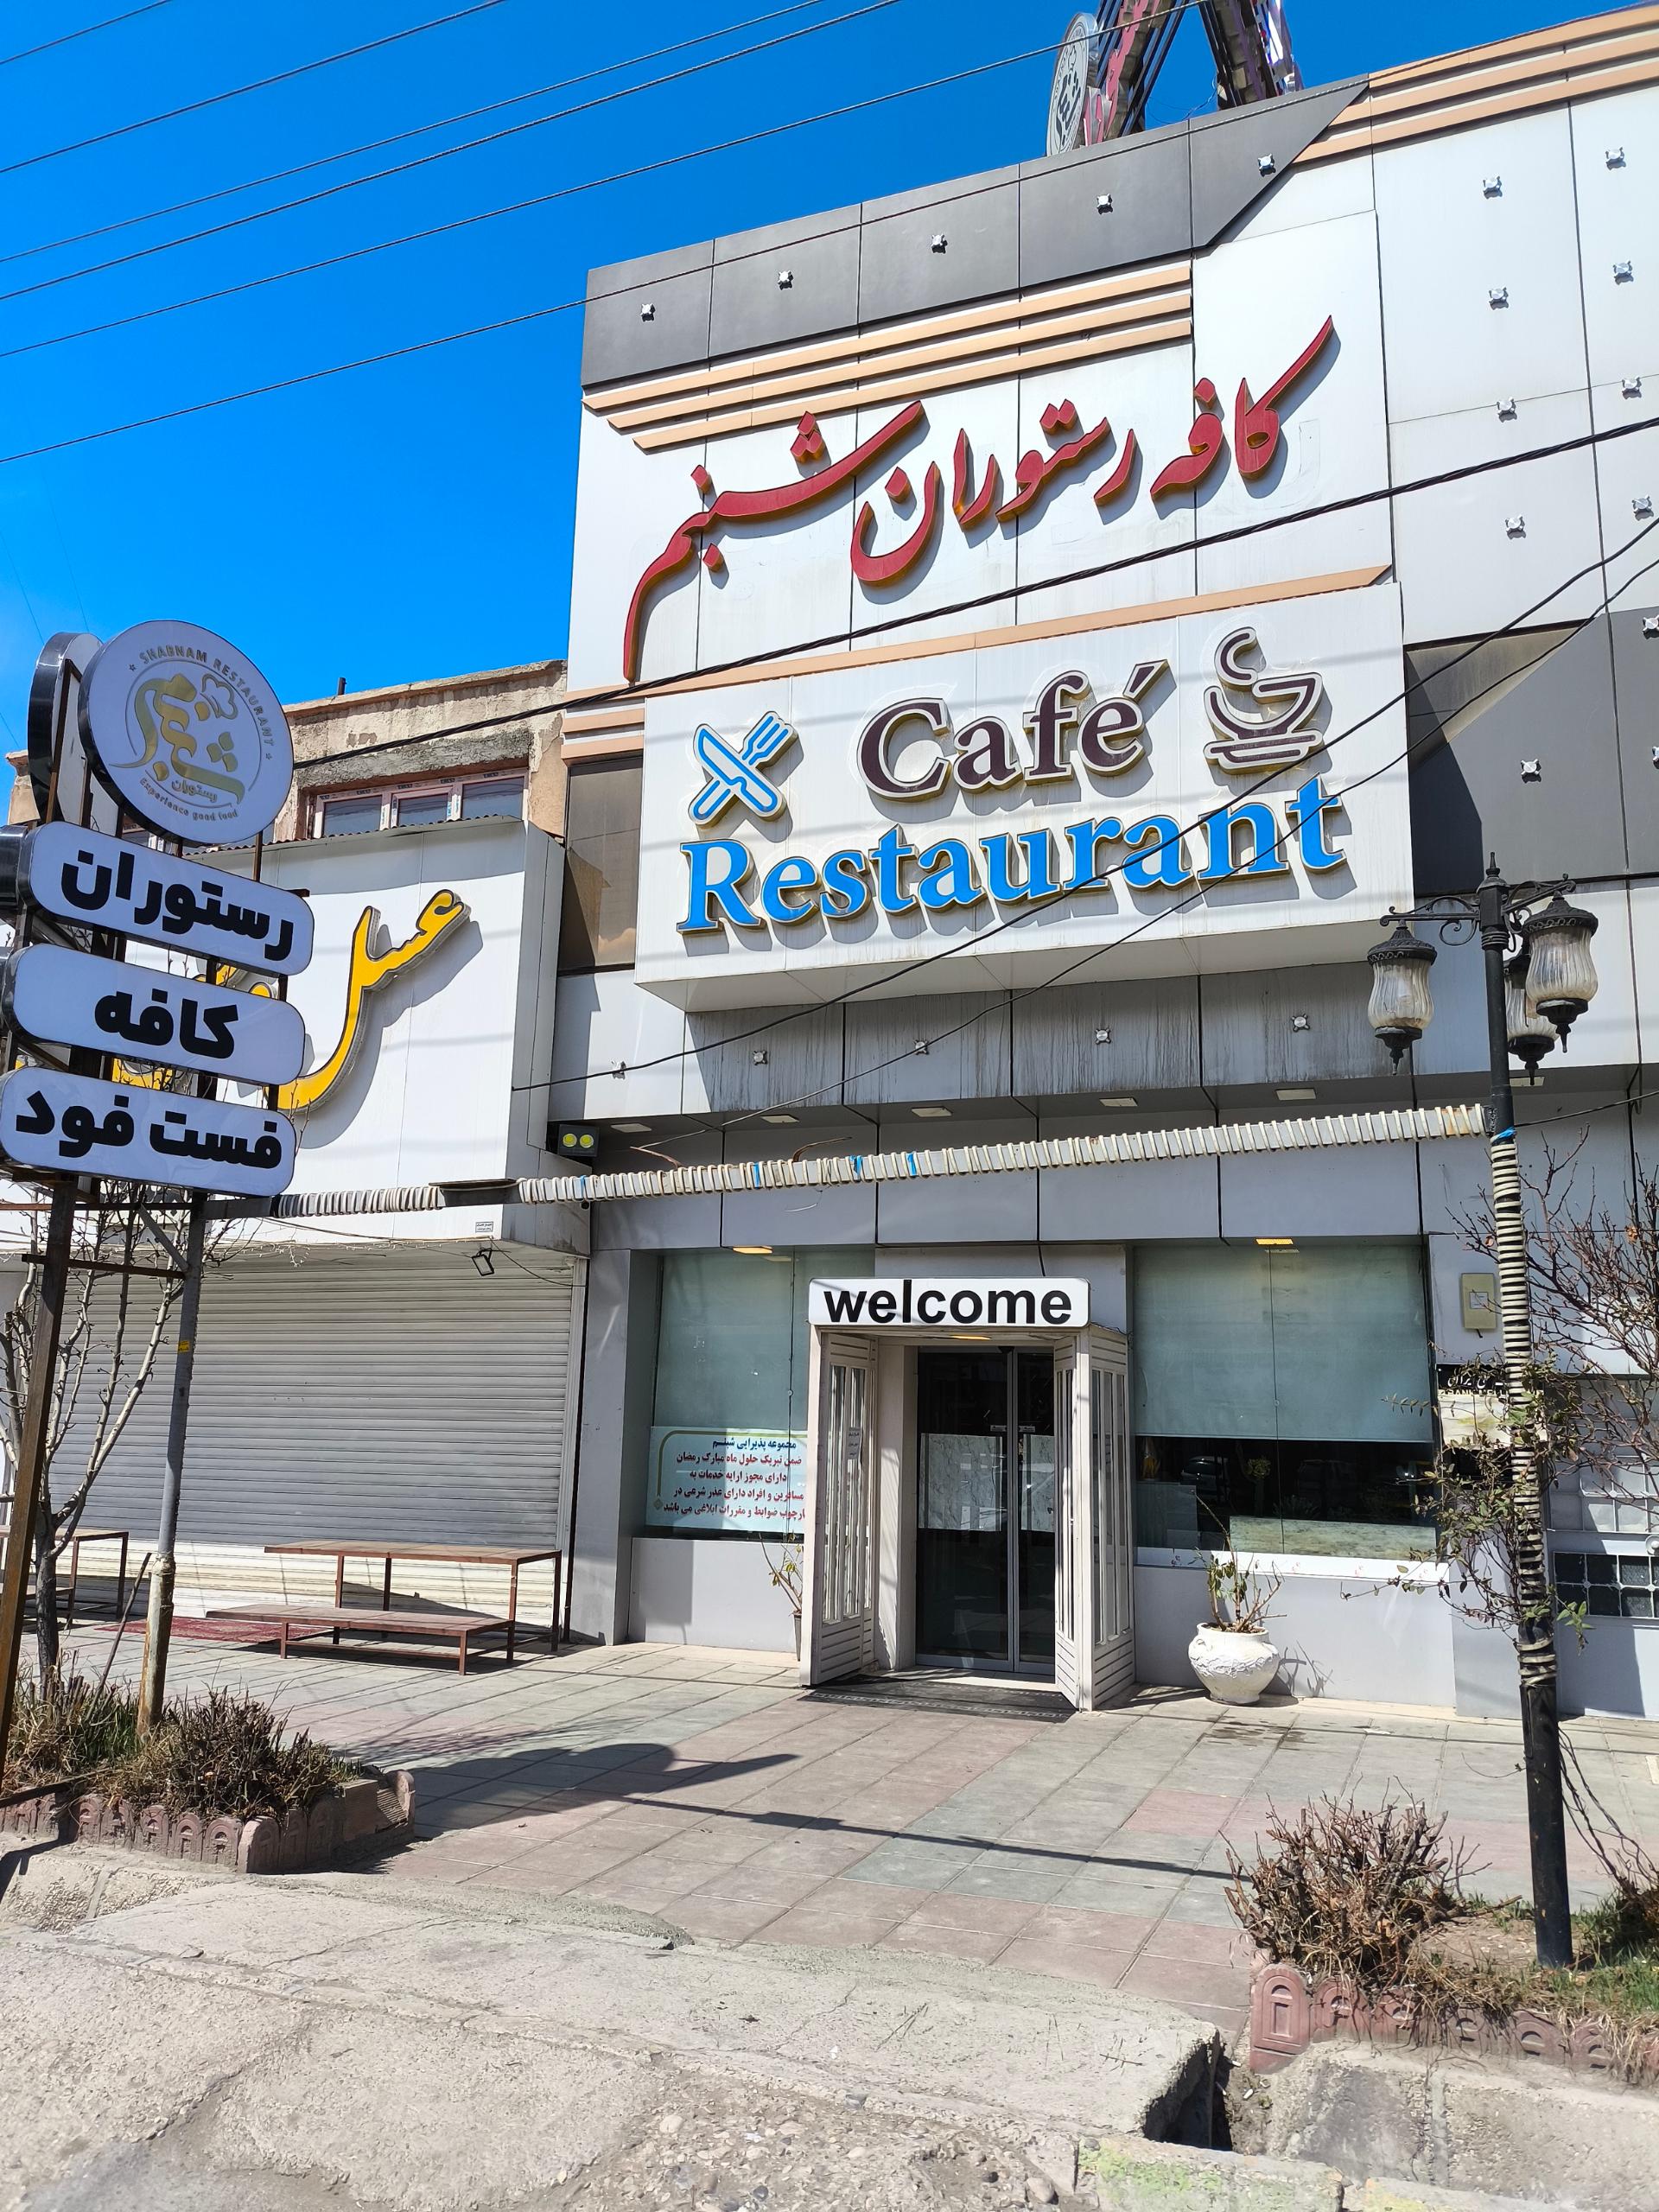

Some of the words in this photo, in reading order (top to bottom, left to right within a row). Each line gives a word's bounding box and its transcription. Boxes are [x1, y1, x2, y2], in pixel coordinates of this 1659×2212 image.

[1150, 315, 1333, 501] کافه
[851, 398, 1138, 588] رستوران
[623, 398, 925, 683] شبنم
[139, 645, 207, 664] SHABNAM
[213, 658, 275, 746] RESTAURANT
[857, 659, 1171, 801] Café
[676, 773, 1348, 935] Restaurant
[61, 849, 295, 960] رستوران
[94, 988, 239, 1059] کافه
[16, 1090, 135, 1158] فود
[149, 1114, 283, 1170] فست
[823, 1279, 1072, 1325] welcome
[736, 1438, 766, 1452] پذیرایی
[767, 1441, 797, 1451] مجموعه
[676, 1452, 700, 1465] رمضان
[702, 1452, 725, 1465] مبارک
[726, 1453, 738, 1462] ماه
[739, 1453, 758, 1465] حلول
[760, 1454, 783, 1467] تبریک
[784, 1456, 802, 1466] ضمن
[690, 1470, 696, 1480] به
[698, 1470, 724, 1478] خدمات
[744, 1472, 763, 1483] مجوز
[765, 1472, 787, 1484] دارای
[673, 1487, 683, 1497] در
[683, 1486, 707, 1498] شرعی
[708, 1486, 722, 1498] عذر
[723, 1488, 746, 1500] دارای
[747, 1488, 766, 1500] افراد
[767, 1492, 772, 1502] و
[773, 1491, 804, 1502] مسافرین
[681, 1506, 693, 1515] می
[719, 1503, 746, 1517] مقررات
[747, 1509, 752, 1518] و
[753, 1506, 778, 1518] ضوابط
